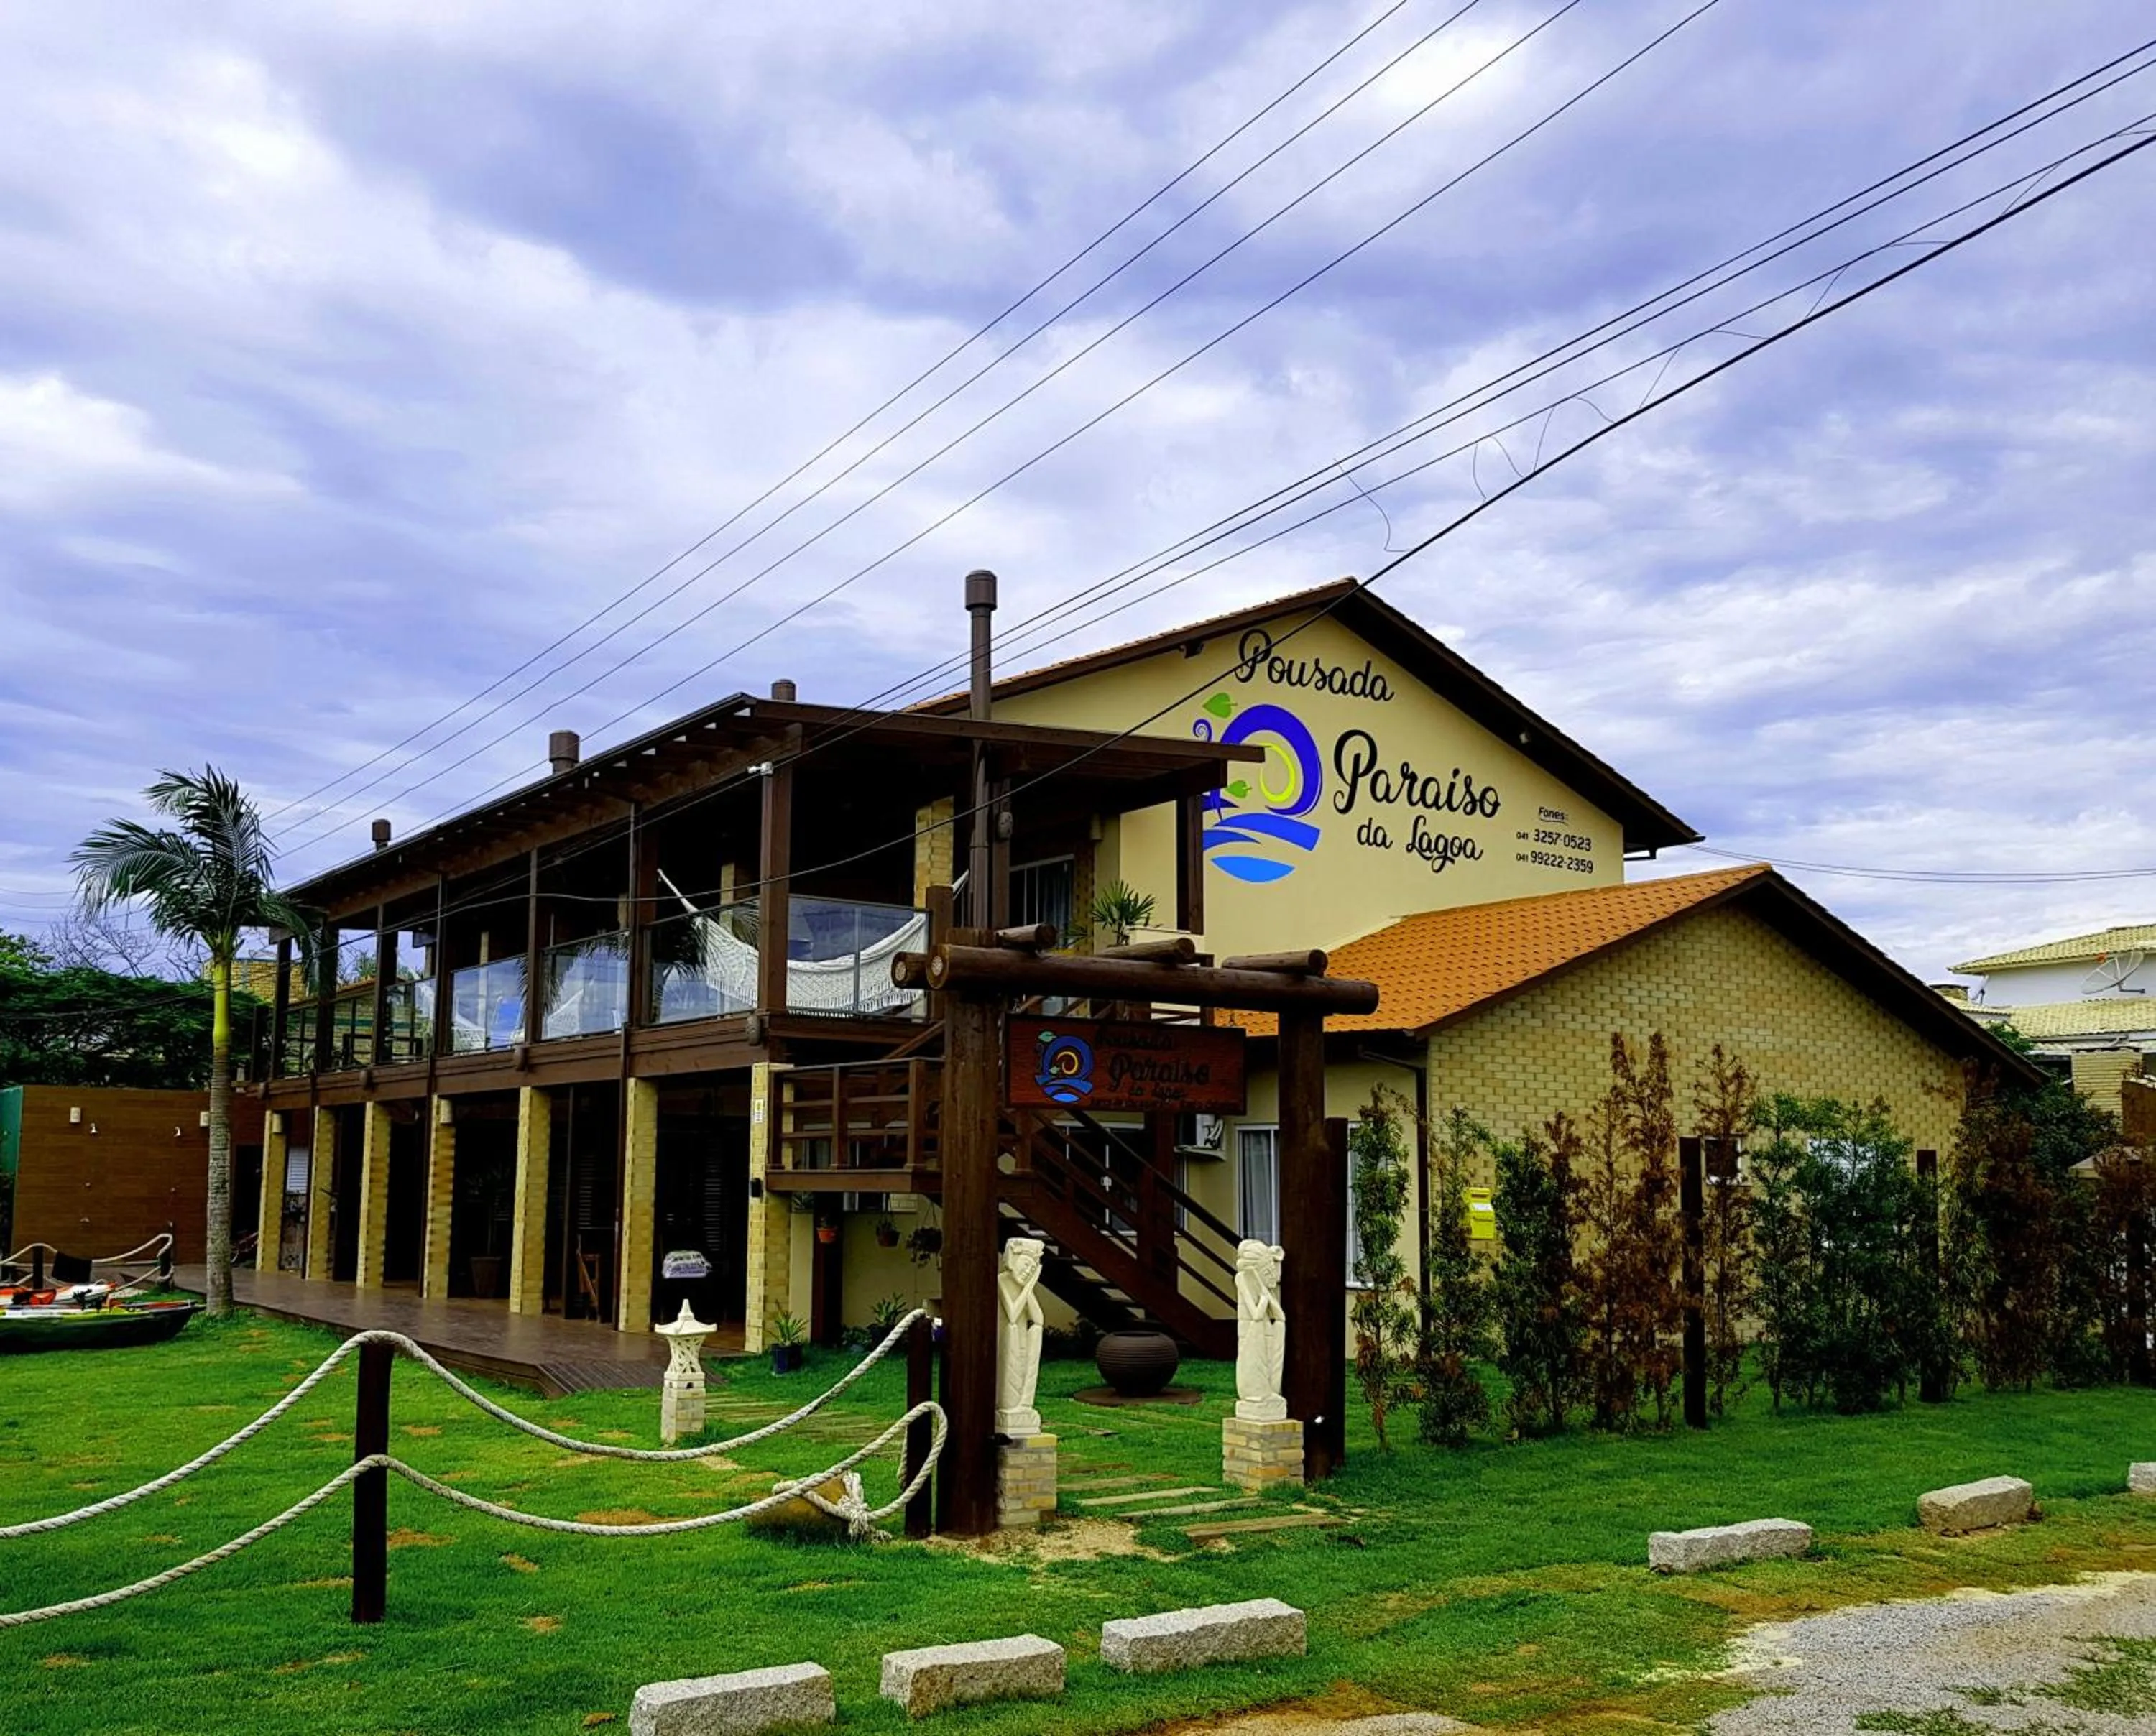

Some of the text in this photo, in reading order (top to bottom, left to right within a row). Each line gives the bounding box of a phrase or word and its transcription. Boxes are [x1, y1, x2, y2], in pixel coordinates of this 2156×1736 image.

[1234, 628, 1395, 702] Pousada
[1333, 729, 1501, 818] Paraiso
[1356, 814, 1484, 874] da Lagoa
[1516, 828, 1592, 851] 041 3257-0523
[1516, 850, 1593, 874] 041 99222-2359
